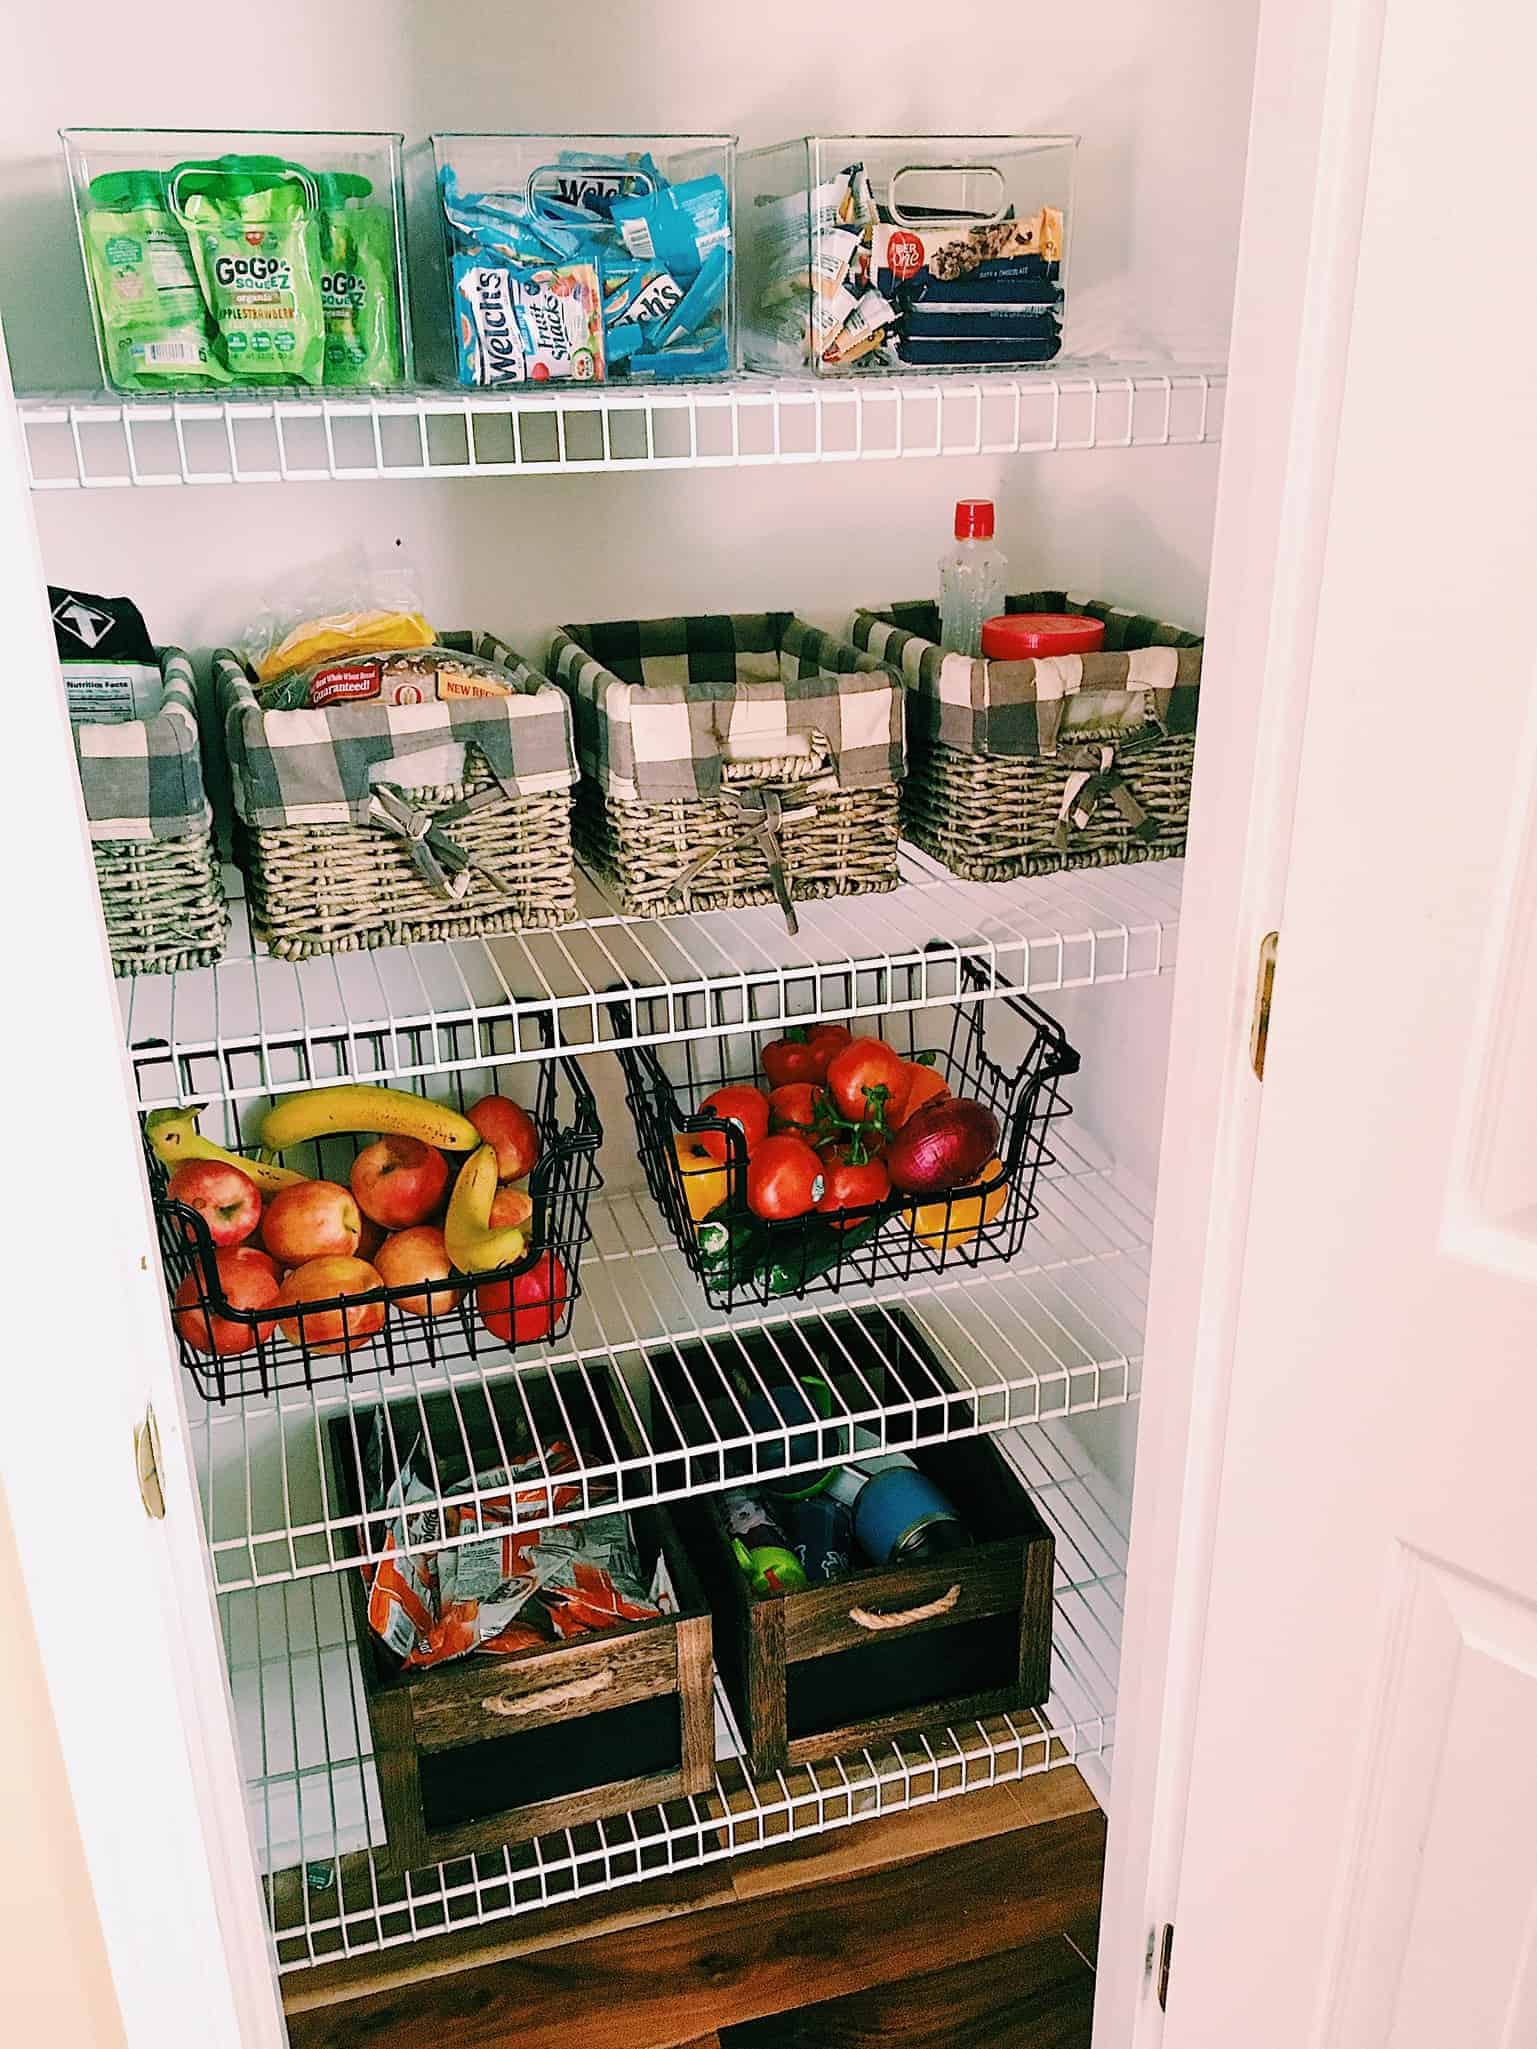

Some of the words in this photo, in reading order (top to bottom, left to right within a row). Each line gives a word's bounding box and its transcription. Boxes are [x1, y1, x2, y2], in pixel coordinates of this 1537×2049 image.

[558, 178, 621, 204] Welc
[215, 257, 279, 286] GoGo
[321, 271, 356, 295] oGo
[477, 272, 517, 383] Welch's
[313, 680, 370, 703] Guaranteed!
[447, 682, 470, 697] NEW
